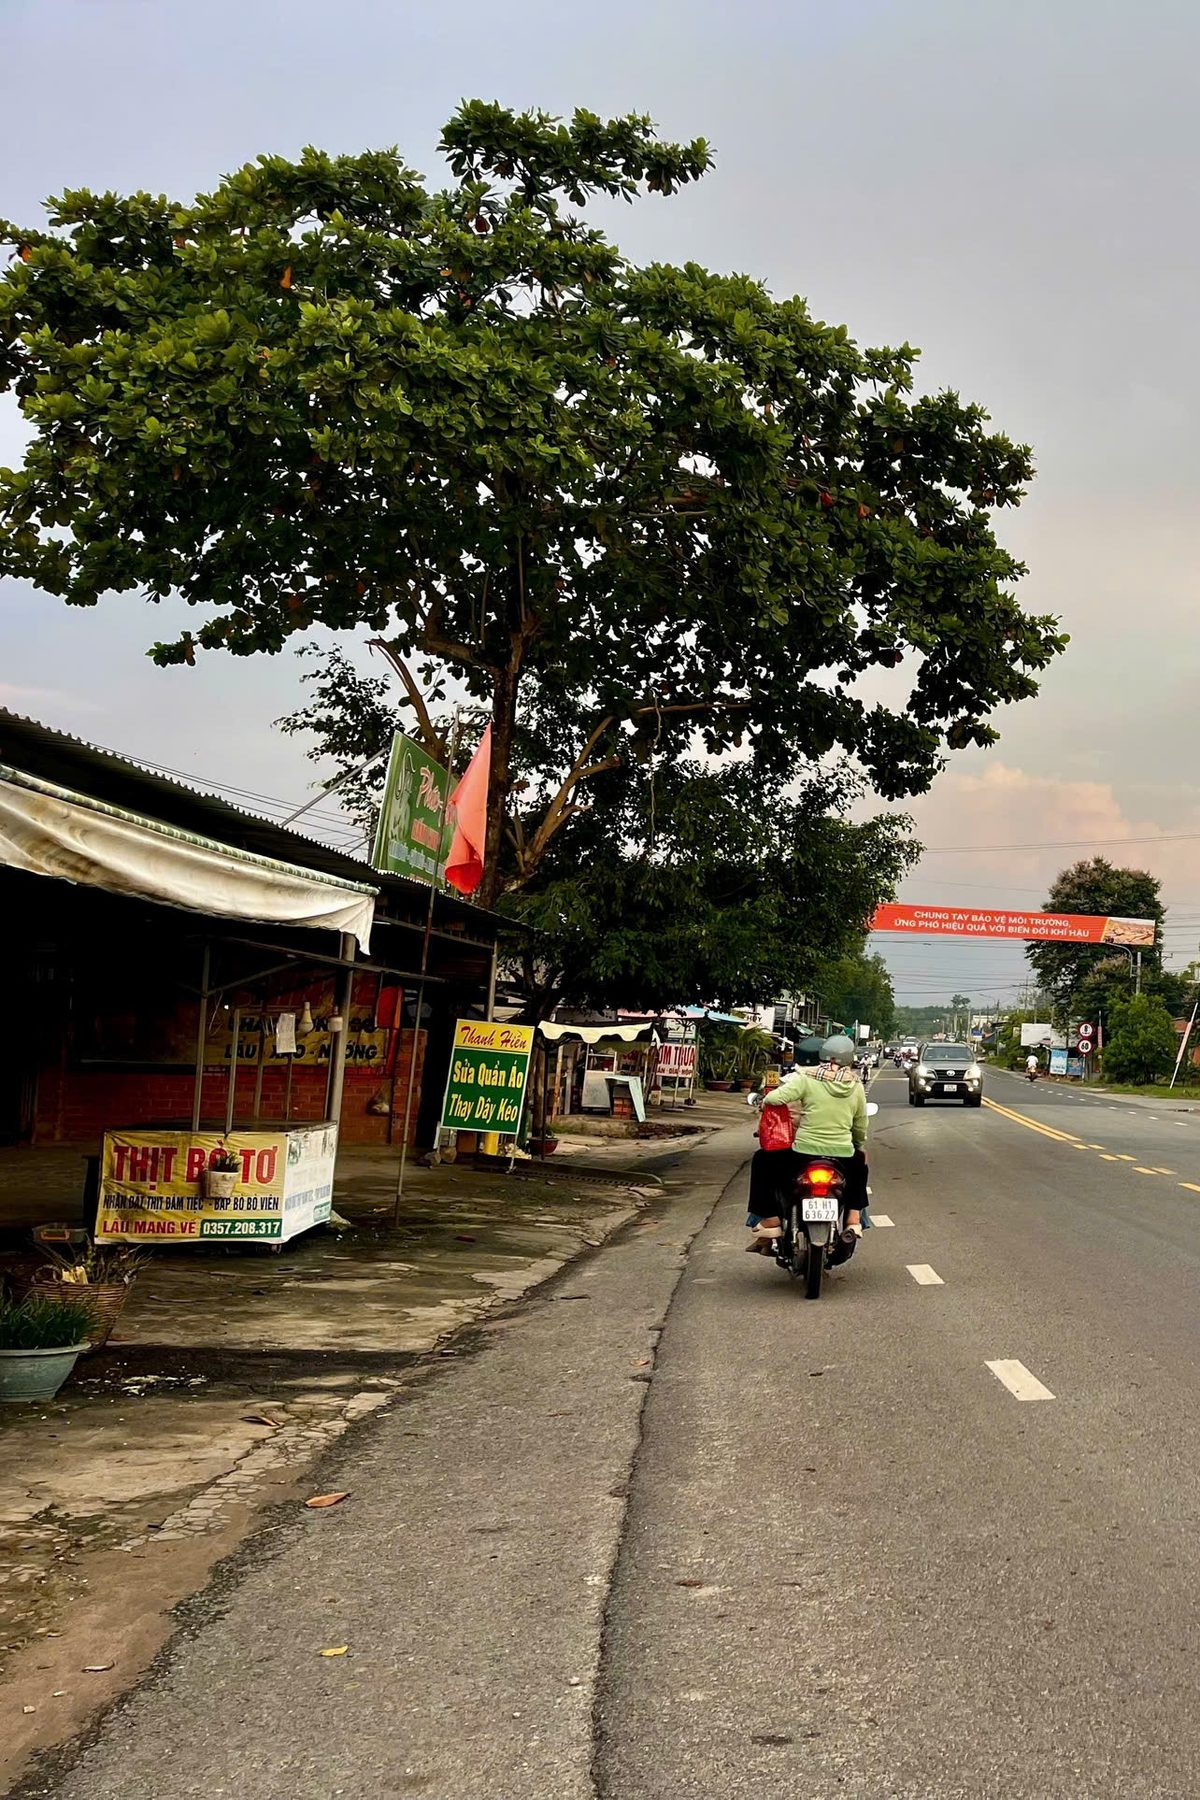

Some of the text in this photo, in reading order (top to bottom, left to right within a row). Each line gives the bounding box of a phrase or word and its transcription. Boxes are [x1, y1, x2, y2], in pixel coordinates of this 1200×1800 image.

[914, 911, 949, 920] CHUNG
[951, 913, 969, 921] TAY
[971, 913, 991, 923] BẢO
[1009, 916, 1027, 924] MÔI
[918, 920, 939, 928] PHÓ
[941, 921, 964, 931] HIỆU
[967, 923, 987, 932] QUẢ
[1050, 928, 1067, 936] KHÍ
[461, 1025, 528, 1049] Thanh Hiền
[453, 1059, 524, 1089] Sửa Quần Áo
[449, 1093, 518, 1124] Thay Dây Kéo
[113, 1145, 178, 1191] THỊT
[239, 1146, 279, 1184] TƠ
[134, 1221, 176, 1233] MANG
[203, 1222, 280, 1235] 0357.208.317
